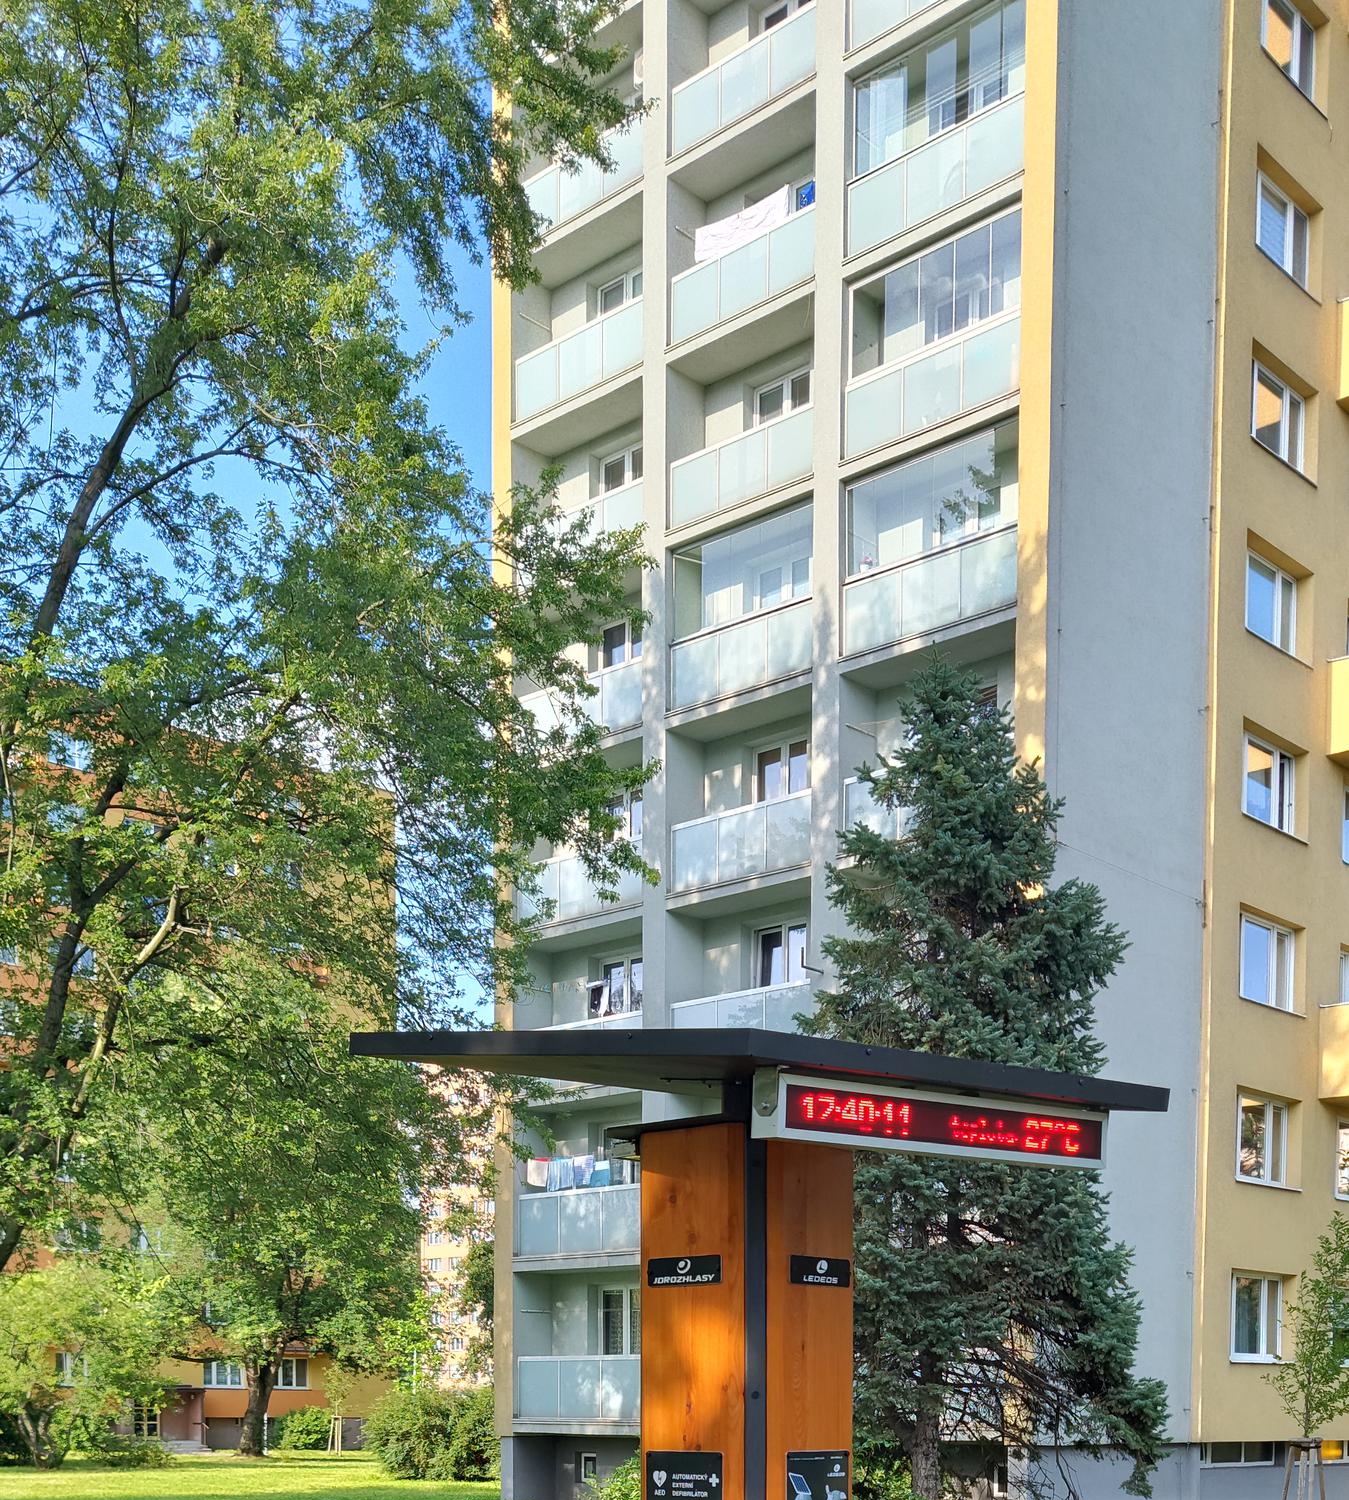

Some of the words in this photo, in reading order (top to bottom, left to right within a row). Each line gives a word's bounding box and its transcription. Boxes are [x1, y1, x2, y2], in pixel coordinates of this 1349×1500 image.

[801, 1095, 911, 1134] 17:40:11
[653, 1274, 715, 1284] JDROZHLASY
[803, 1275, 839, 1284] LEDEOS
